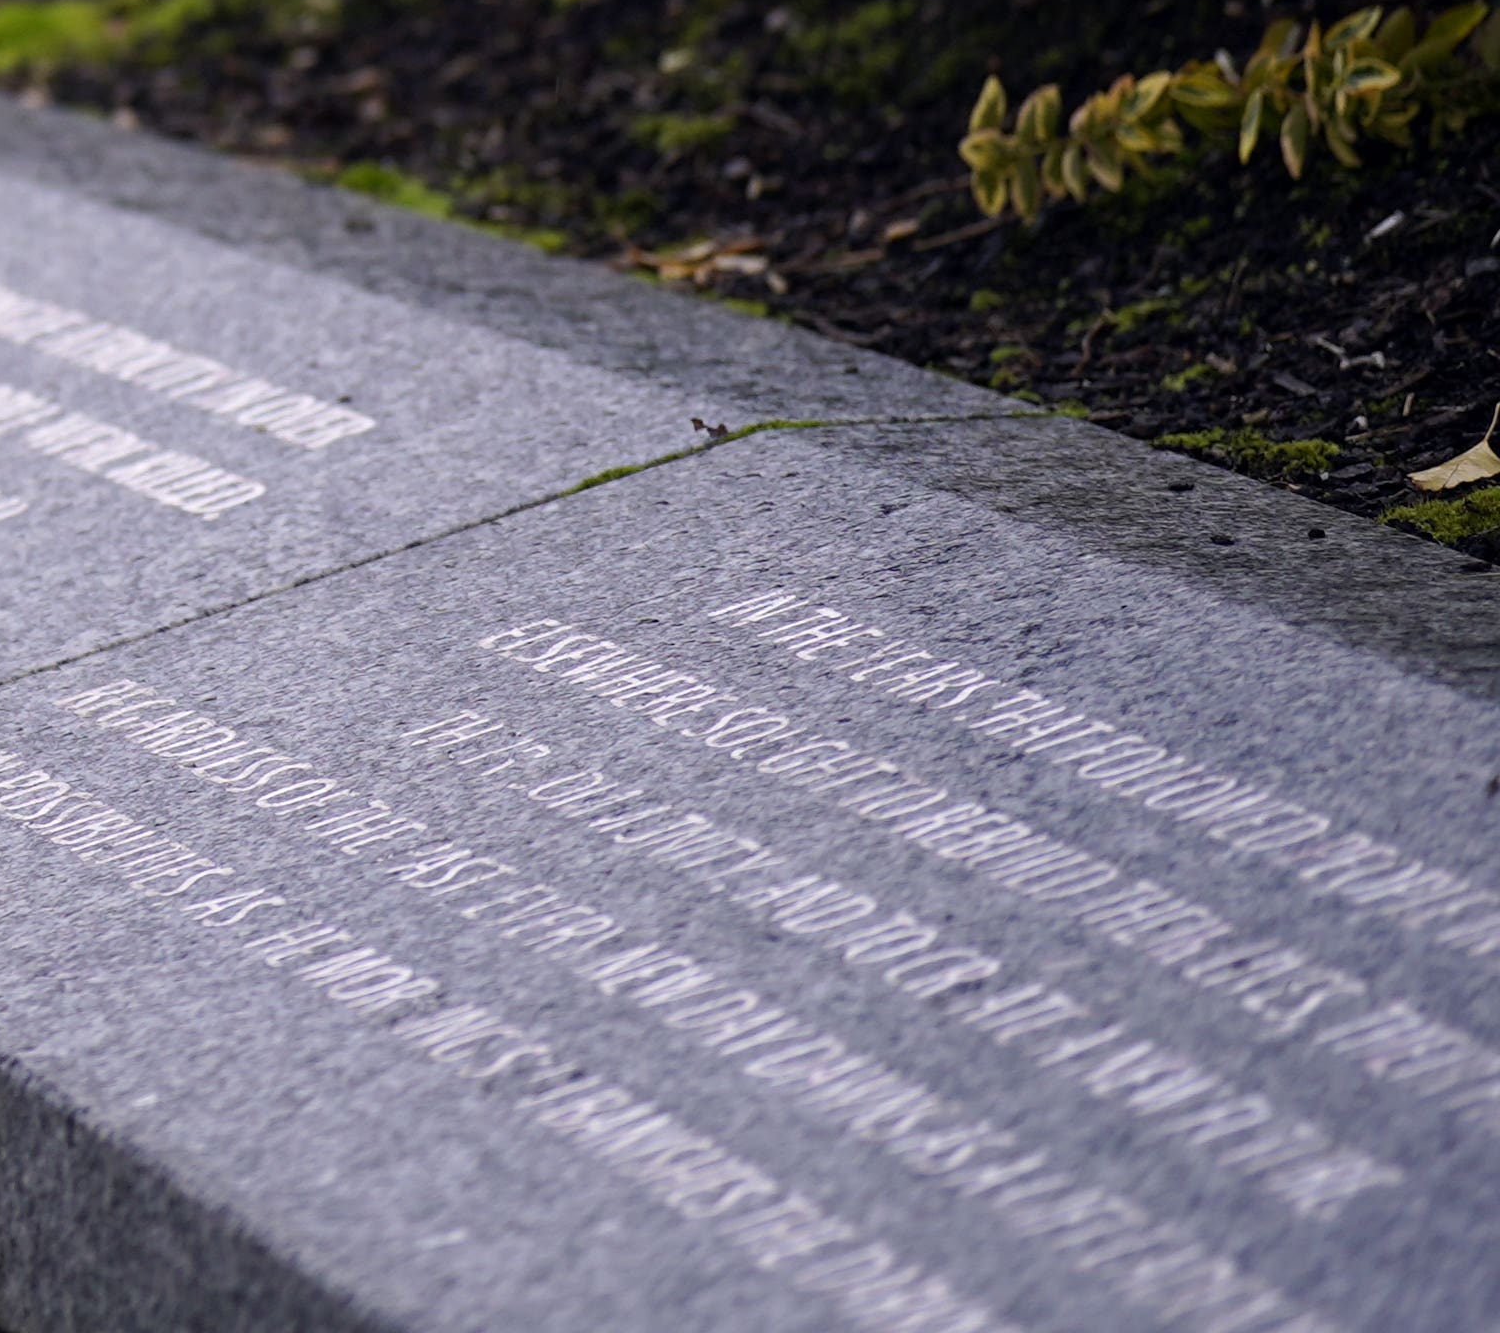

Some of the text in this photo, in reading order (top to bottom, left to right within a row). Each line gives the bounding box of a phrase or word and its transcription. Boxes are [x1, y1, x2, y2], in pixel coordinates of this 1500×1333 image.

[707, 589, 808, 628] IN
[756, 607, 884, 660] THE
[838, 641, 1004, 710] YEARS
[56, 679, 313, 792] REGARDLESS
[955, 687, 1116, 754] THAT
[256, 778, 360, 815] OF
[479, 619, 738, 726] ELSEWHERE
[681, 707, 899, 793] SOUGHT
[838, 771, 948, 820] TO
[894, 801, 1118, 901] REBUILD
[1073, 881, 1233, 965] THEIR
[303, 799, 428, 855] THE
[403, 709, 550, 776] THIR
[730, 874, 876, 933] AND
[822, 910, 938, 964] TO
[883, 946, 1092, 1044] CRATE
[180, 888, 286, 926] AS
[243, 919, 352, 967] HE
[299, 947, 520, 1064] MORING
[580, 942, 727, 1008] NEW
[663, 990, 804, 1056] DAY
[744, 1035, 962, 1139] DAWNS
